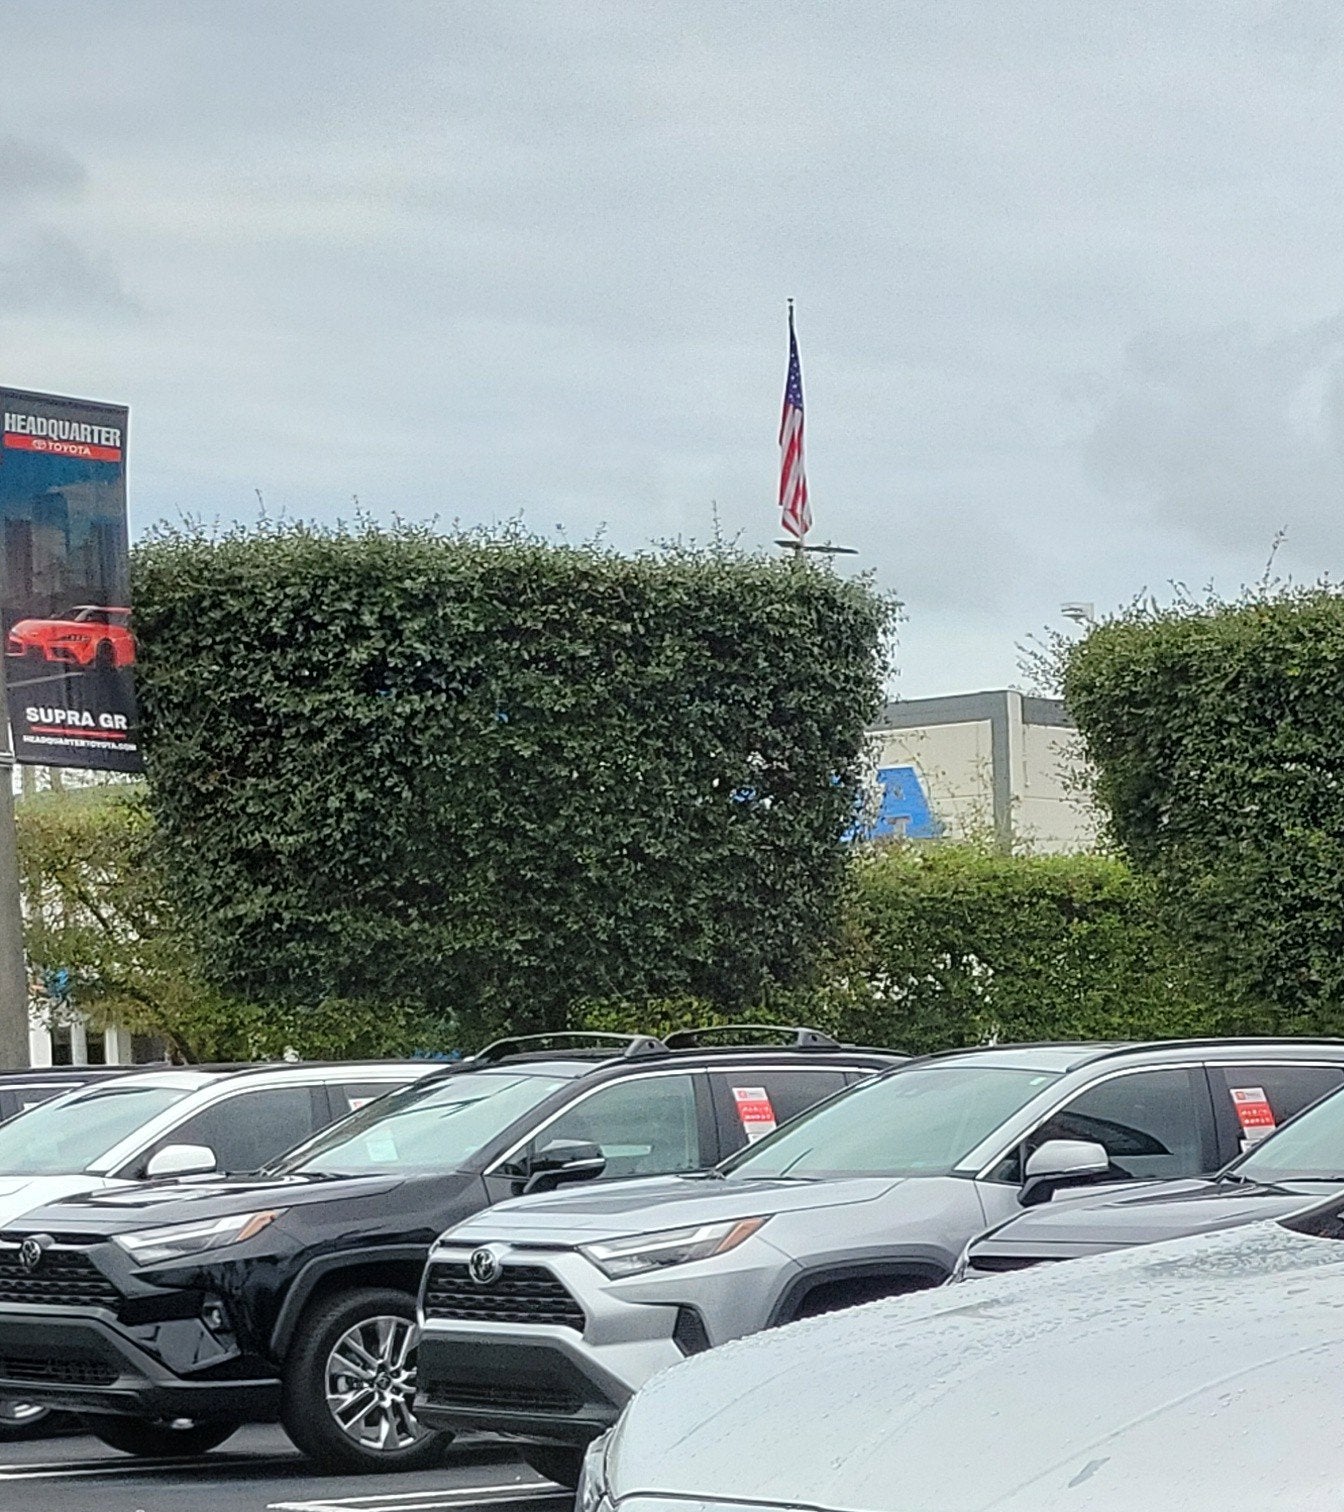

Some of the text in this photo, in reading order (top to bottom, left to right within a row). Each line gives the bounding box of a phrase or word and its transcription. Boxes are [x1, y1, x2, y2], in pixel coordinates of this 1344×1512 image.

[4, 412, 121, 447] HEADQUARTER
[48, 441, 91, 456] TOYOTA
[26, 706, 128, 730] SUPRA GR
